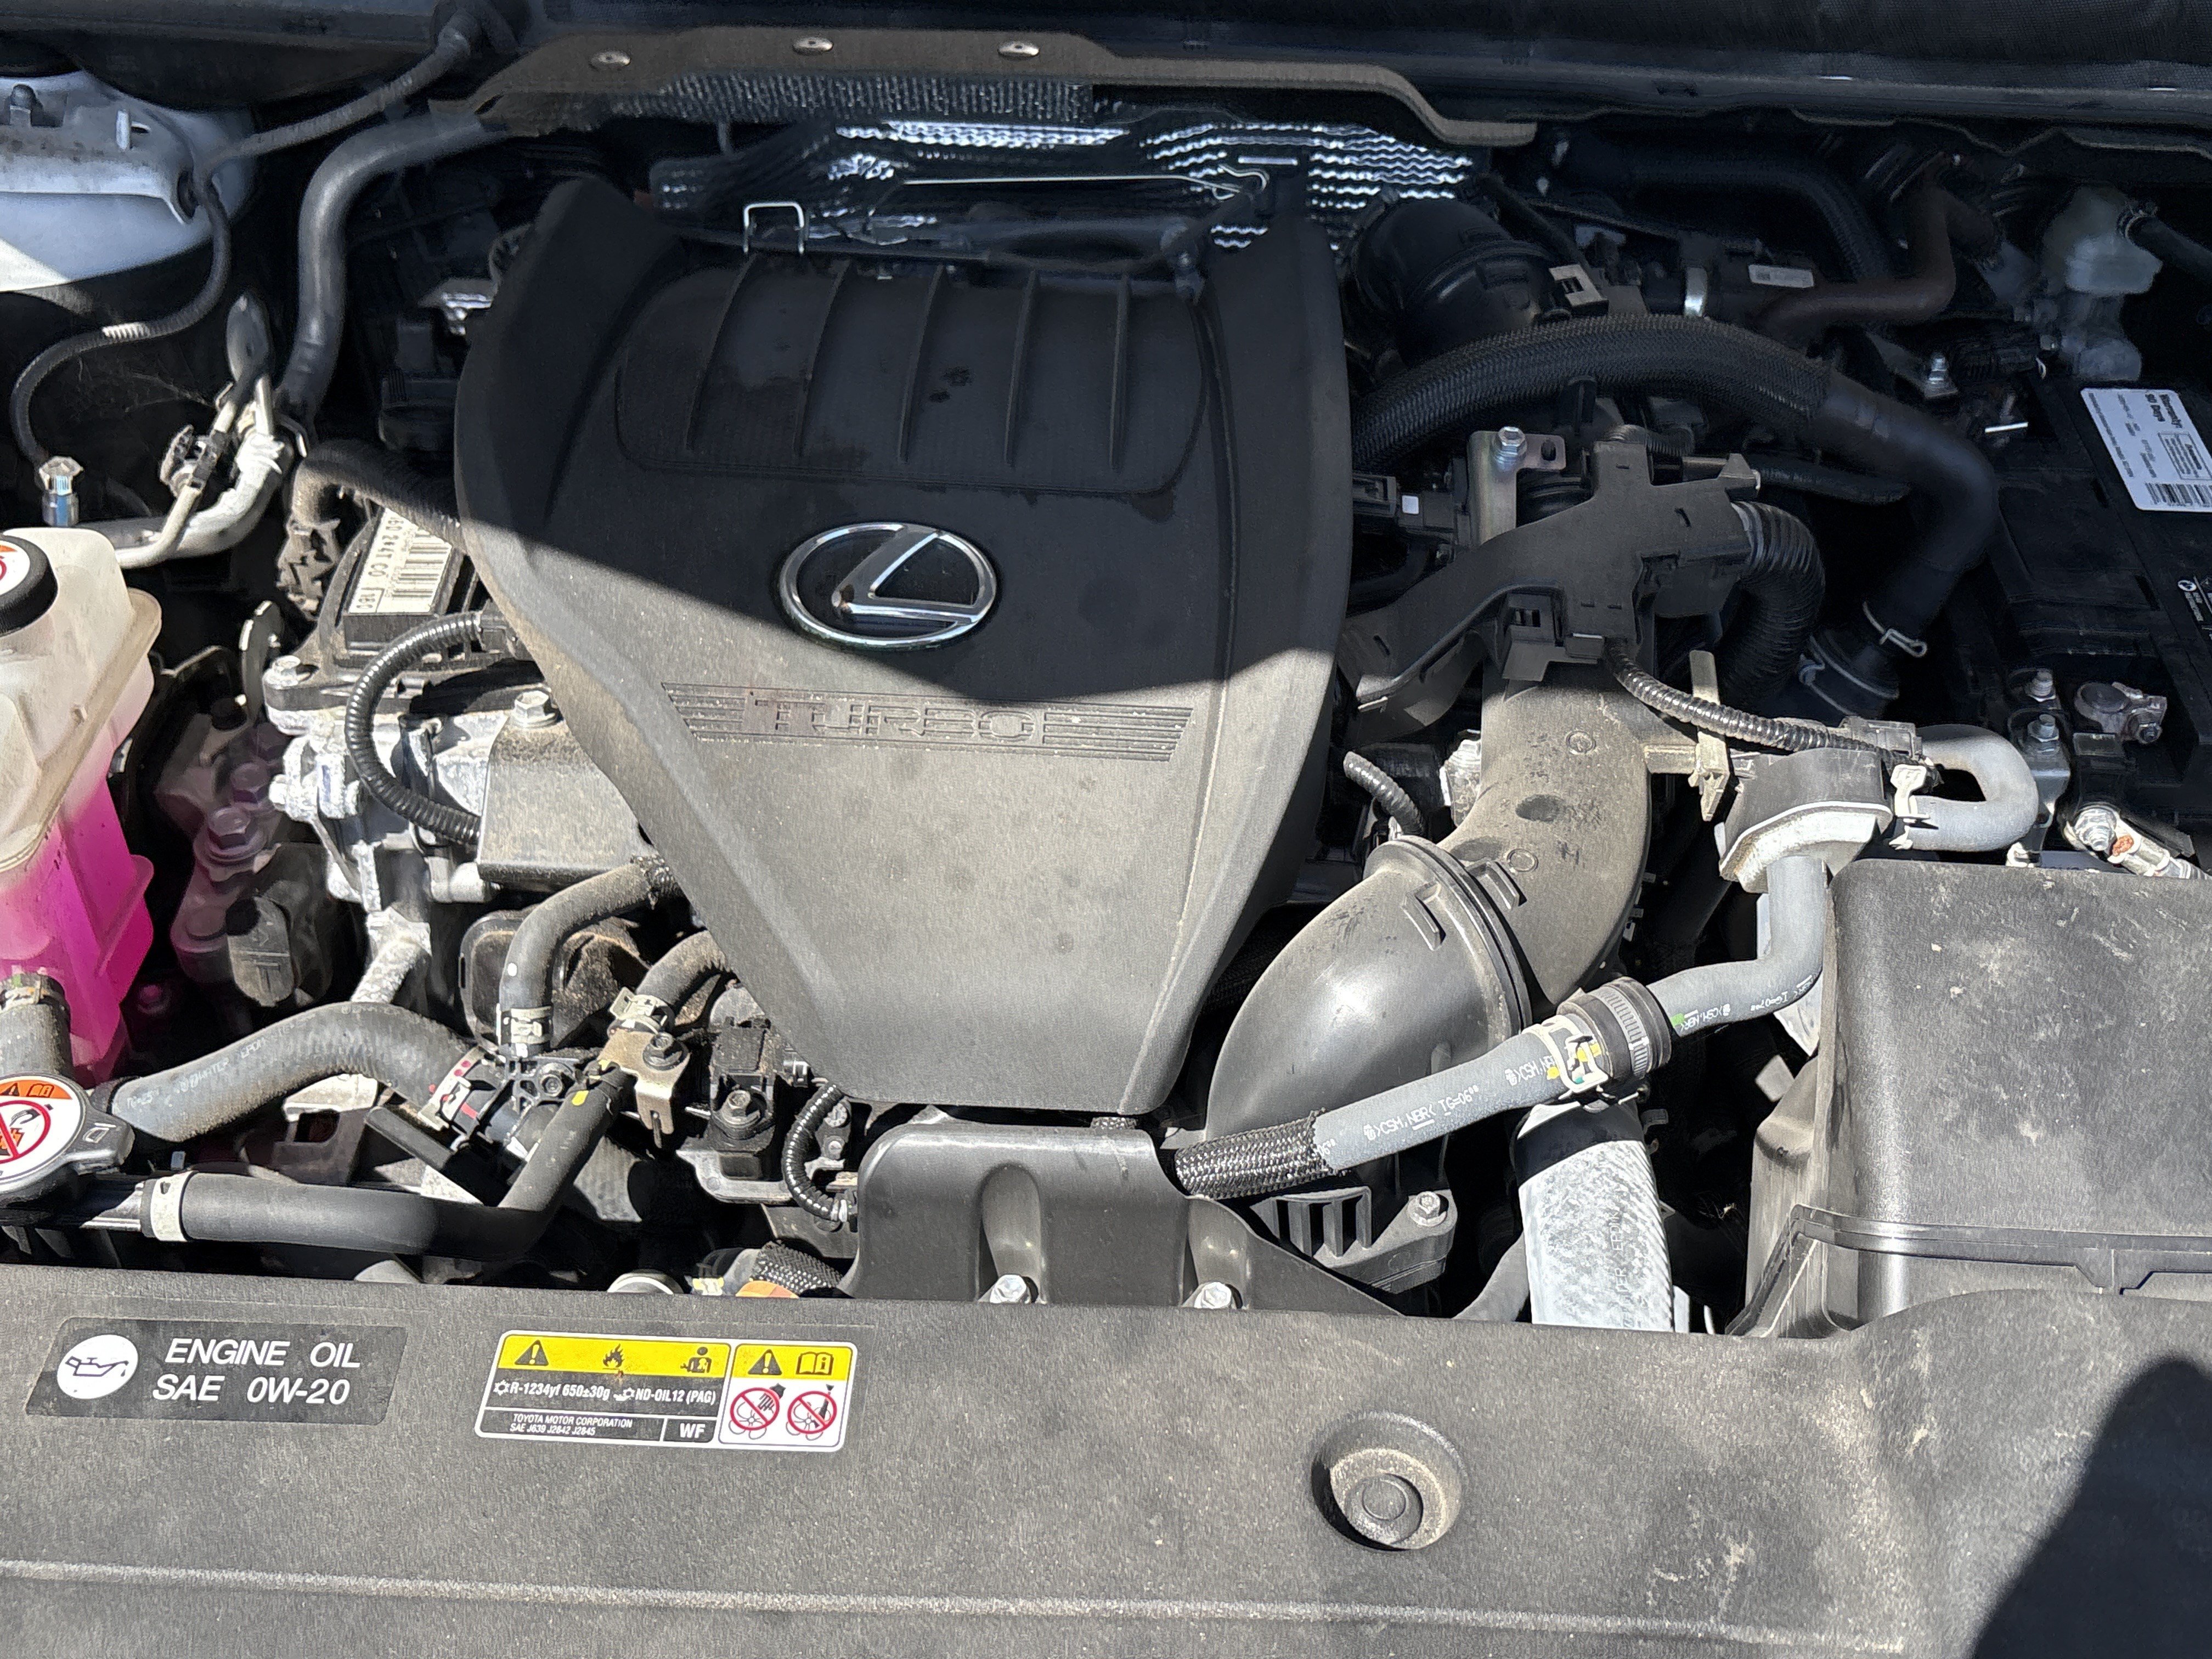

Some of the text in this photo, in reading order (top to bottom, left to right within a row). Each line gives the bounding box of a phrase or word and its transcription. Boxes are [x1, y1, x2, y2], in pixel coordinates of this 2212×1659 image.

[755, 698, 1034, 741] TURBO
[165, 1338, 361, 1368] ENGINE OIL
[153, 1373, 351, 1405] SAE 0W-20
[510, 1381, 560, 1398] R-1234yf
[635, 1388, 684, 1402] ND-OIL12
[686, 1390, 716, 1405] (PAG)
[510, 1423, 526, 1433] SAE
[527, 1424, 547, 1434] J639
[513, 1413, 633, 1429] TOYOTA MOTOR CORPORATION
[679, 1423, 706, 1438] WF
